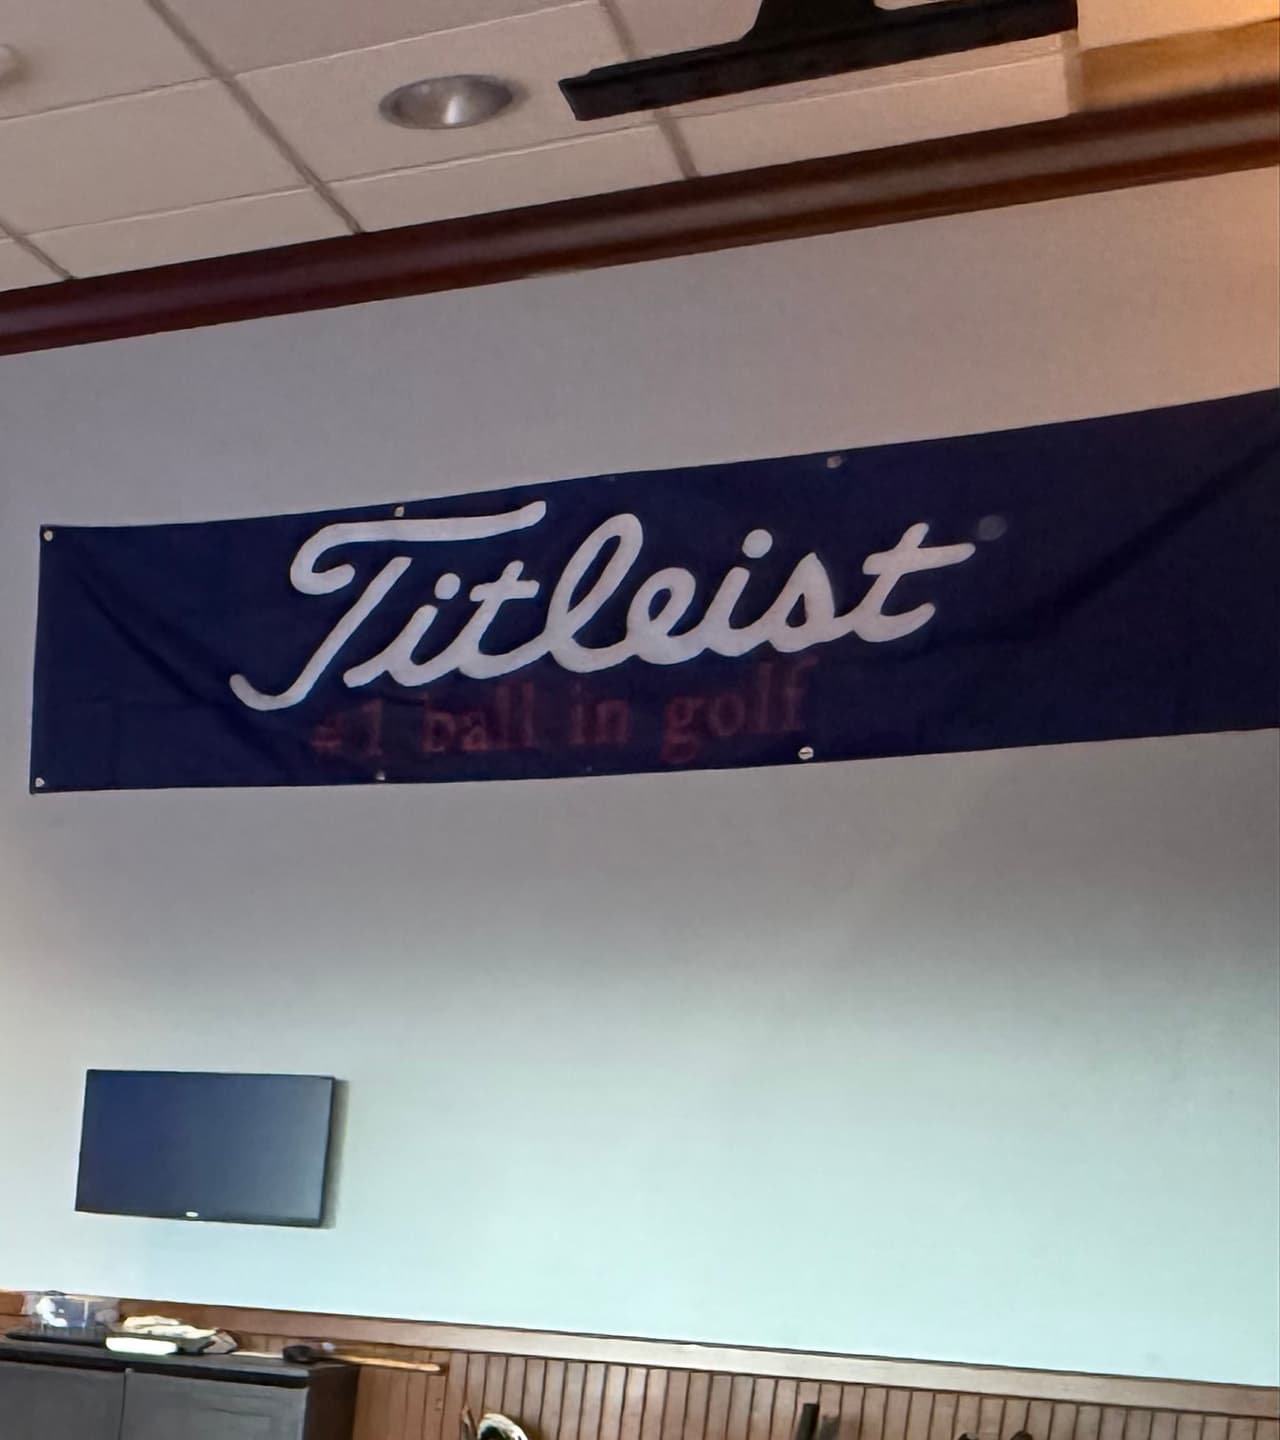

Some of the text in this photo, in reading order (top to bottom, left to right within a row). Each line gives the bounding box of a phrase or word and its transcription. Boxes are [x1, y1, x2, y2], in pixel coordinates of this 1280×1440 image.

[230, 499, 976, 711] Titleist
[422, 682, 538, 753] ball
[569, 674, 632, 747] in
[662, 653, 823, 764] golf
